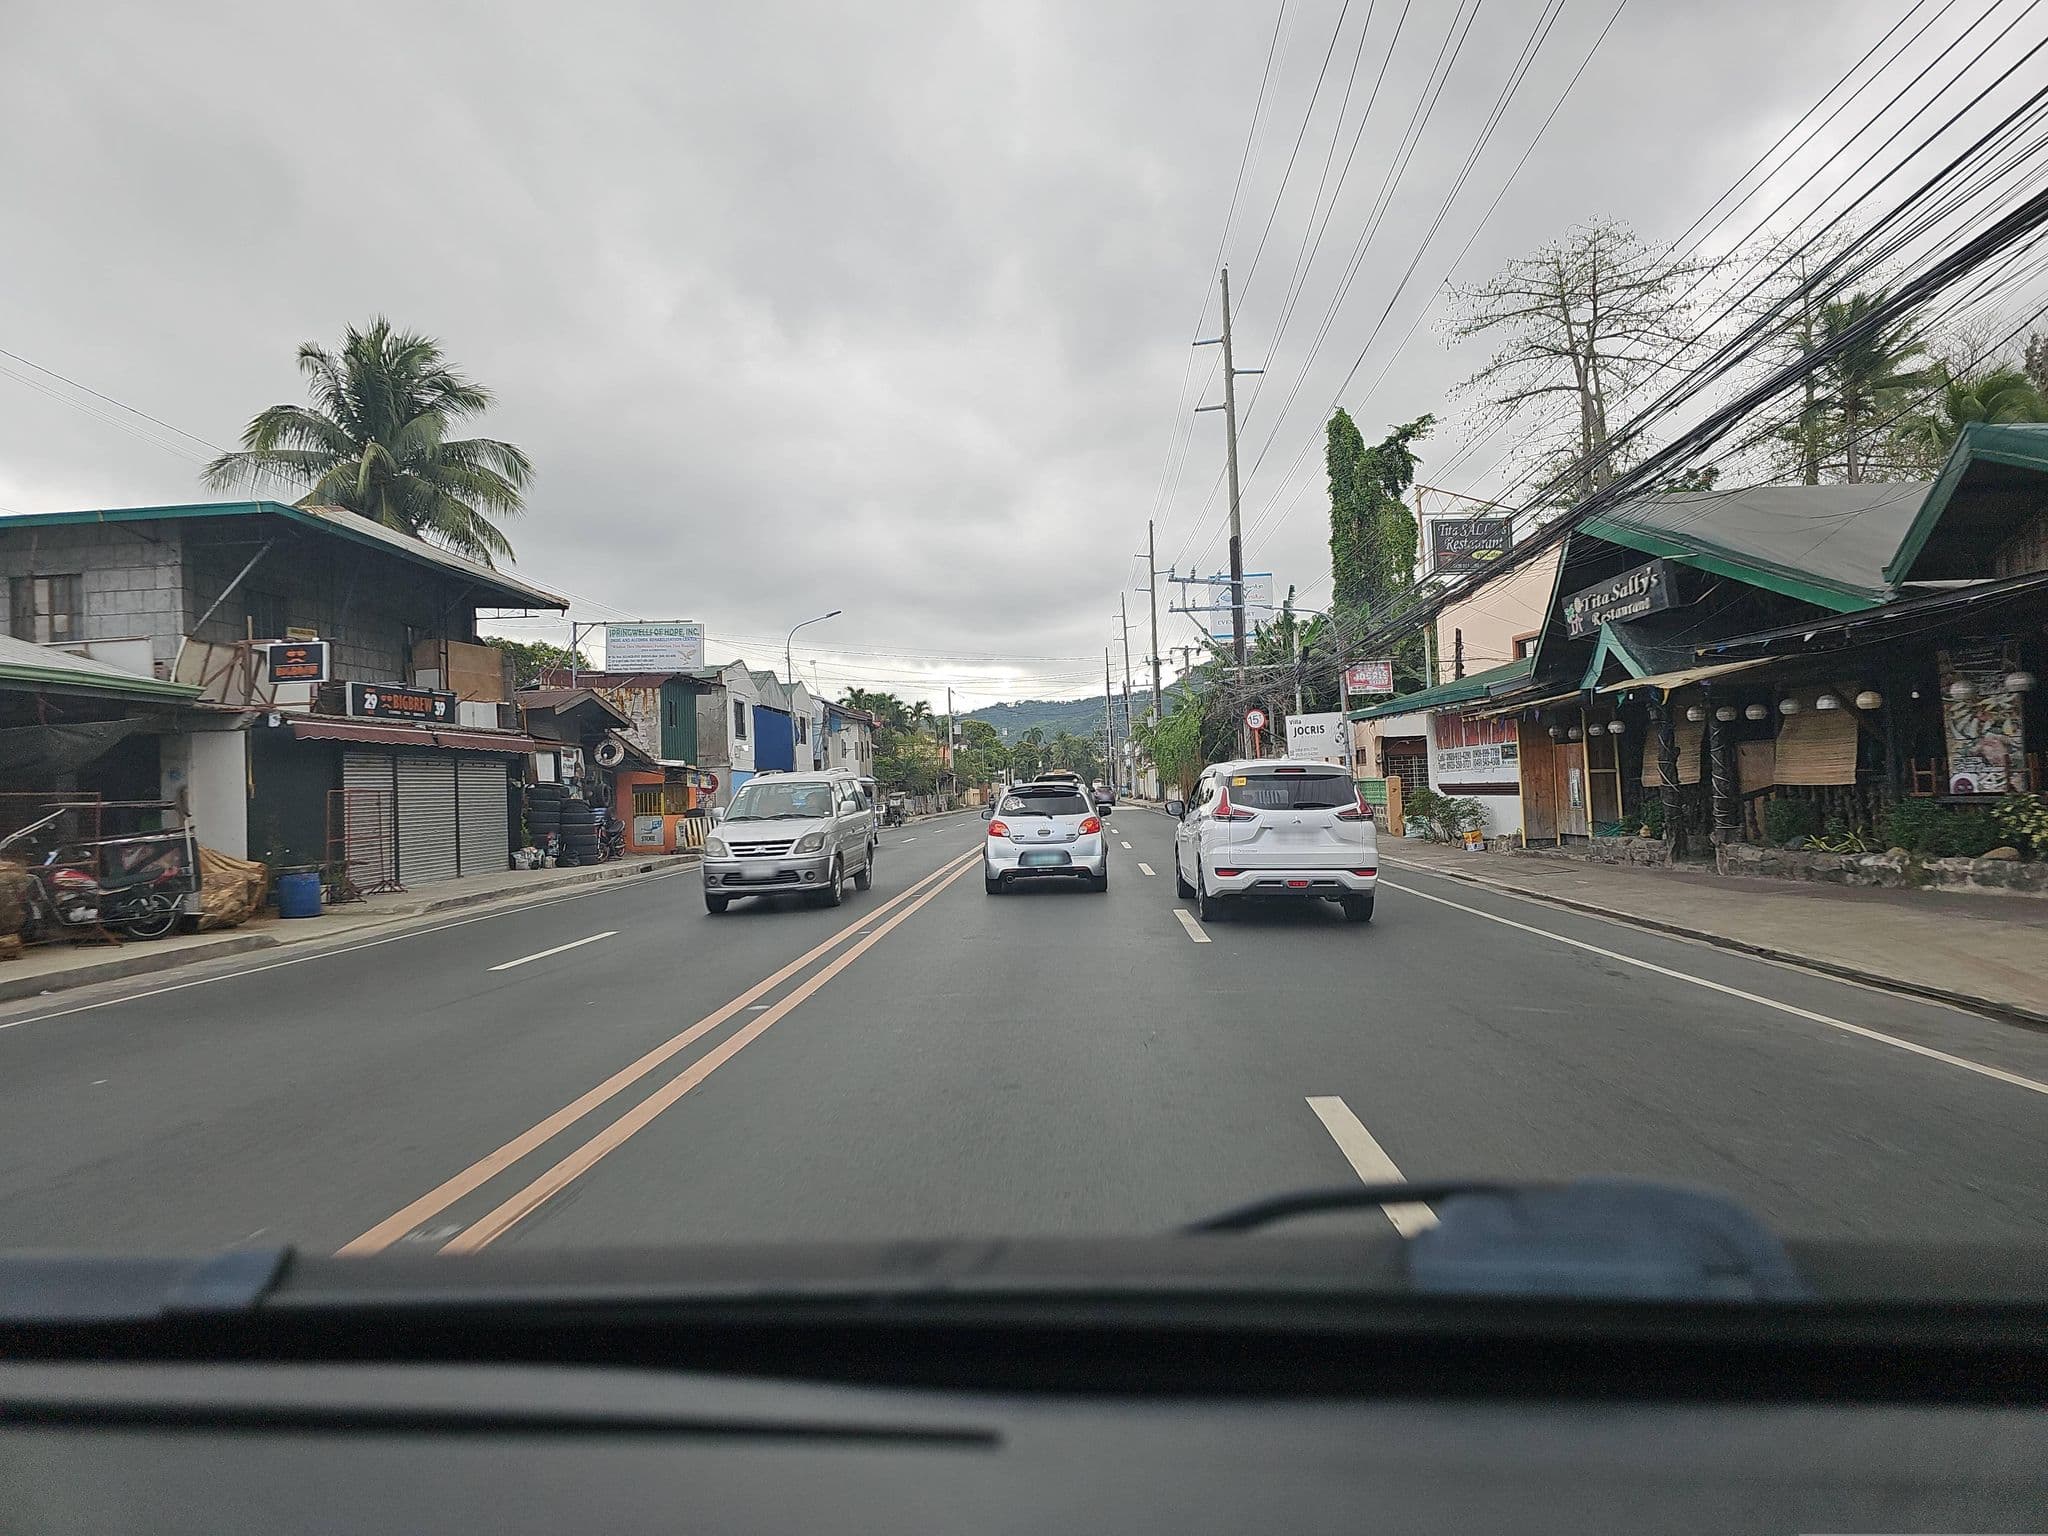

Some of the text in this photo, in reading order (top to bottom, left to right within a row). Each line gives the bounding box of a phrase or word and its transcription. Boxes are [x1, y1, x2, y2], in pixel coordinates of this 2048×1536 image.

[1438, 523, 1458, 537] Tita
[1581, 566, 1659, 612] Tita Sally's
[1591, 596, 1652, 626] Restaurant
[609, 628, 652, 637] SPRINGWELLS
[653, 628, 663, 637] OF
[686, 627, 700, 636] INC.
[364, 693, 378, 709] 29
[393, 694, 433, 712] BIGBREW
[434, 701, 446, 716] 39
[1293, 725, 1325, 738] JOCRIS
